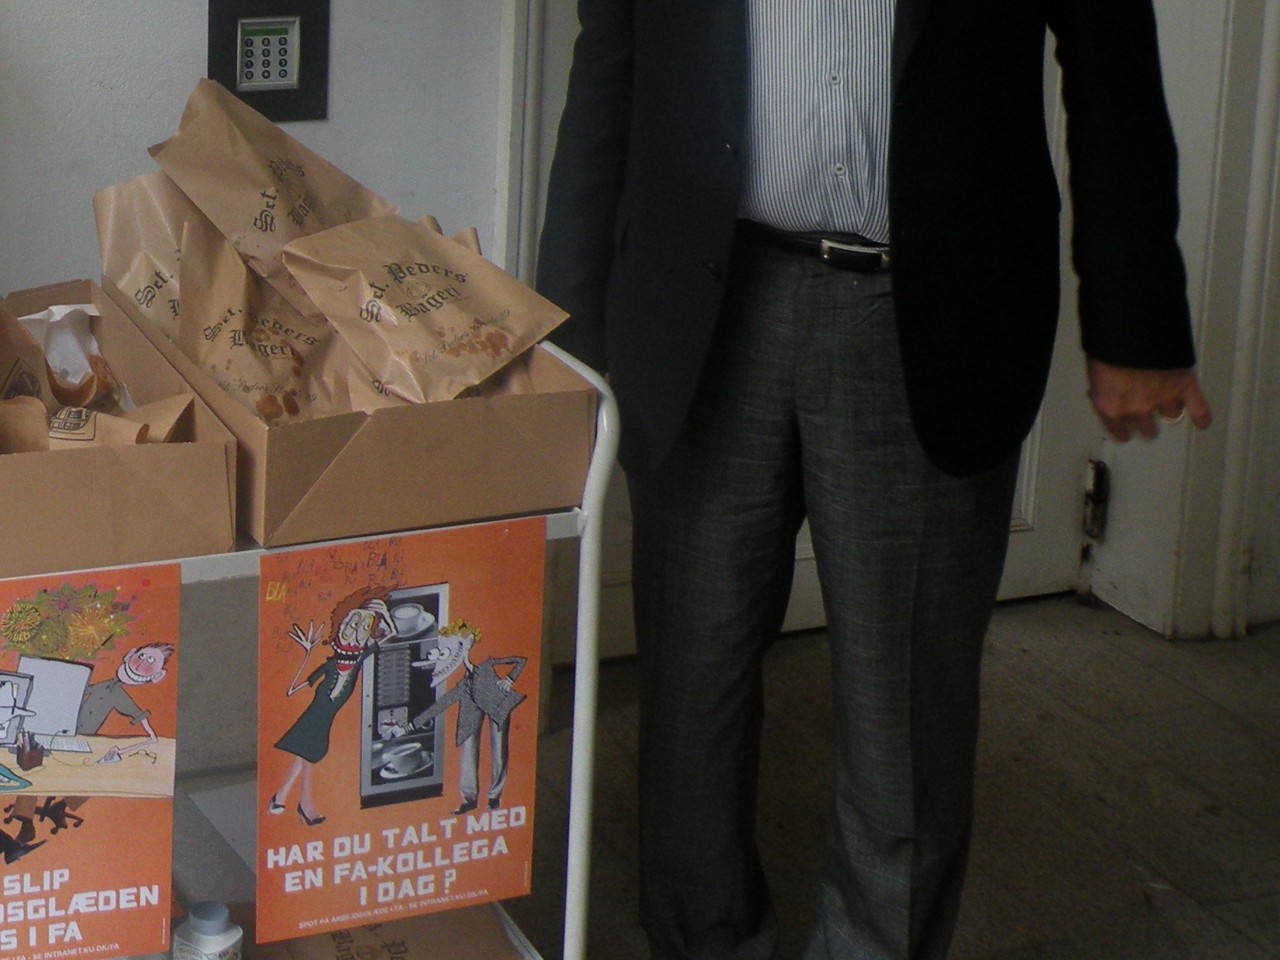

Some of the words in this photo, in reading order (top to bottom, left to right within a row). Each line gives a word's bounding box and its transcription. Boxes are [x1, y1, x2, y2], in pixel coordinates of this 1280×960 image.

[134, 268, 174, 309] Sct.
[359, 281, 390, 323] Sct.
[382, 261, 469, 284] Peders
[203, 306, 243, 342] Sct.
[250, 314, 318, 346] eders
[266, 840, 324, 869] HAR
[333, 833, 371, 858] DU
[382, 817, 458, 849] TALT
[466, 804, 527, 835] MED
[3, 868, 70, 896] SLIP
[284, 867, 323, 893] EN
[333, 835, 509, 884] FA-KOLLEGA
[359, 885, 368, 906] I
[377, 873, 436, 903] DAG
[28, 926, 38, 947] I
[48, 920, 83, 946] FA
[298, 919, 318, 930] SPOT
